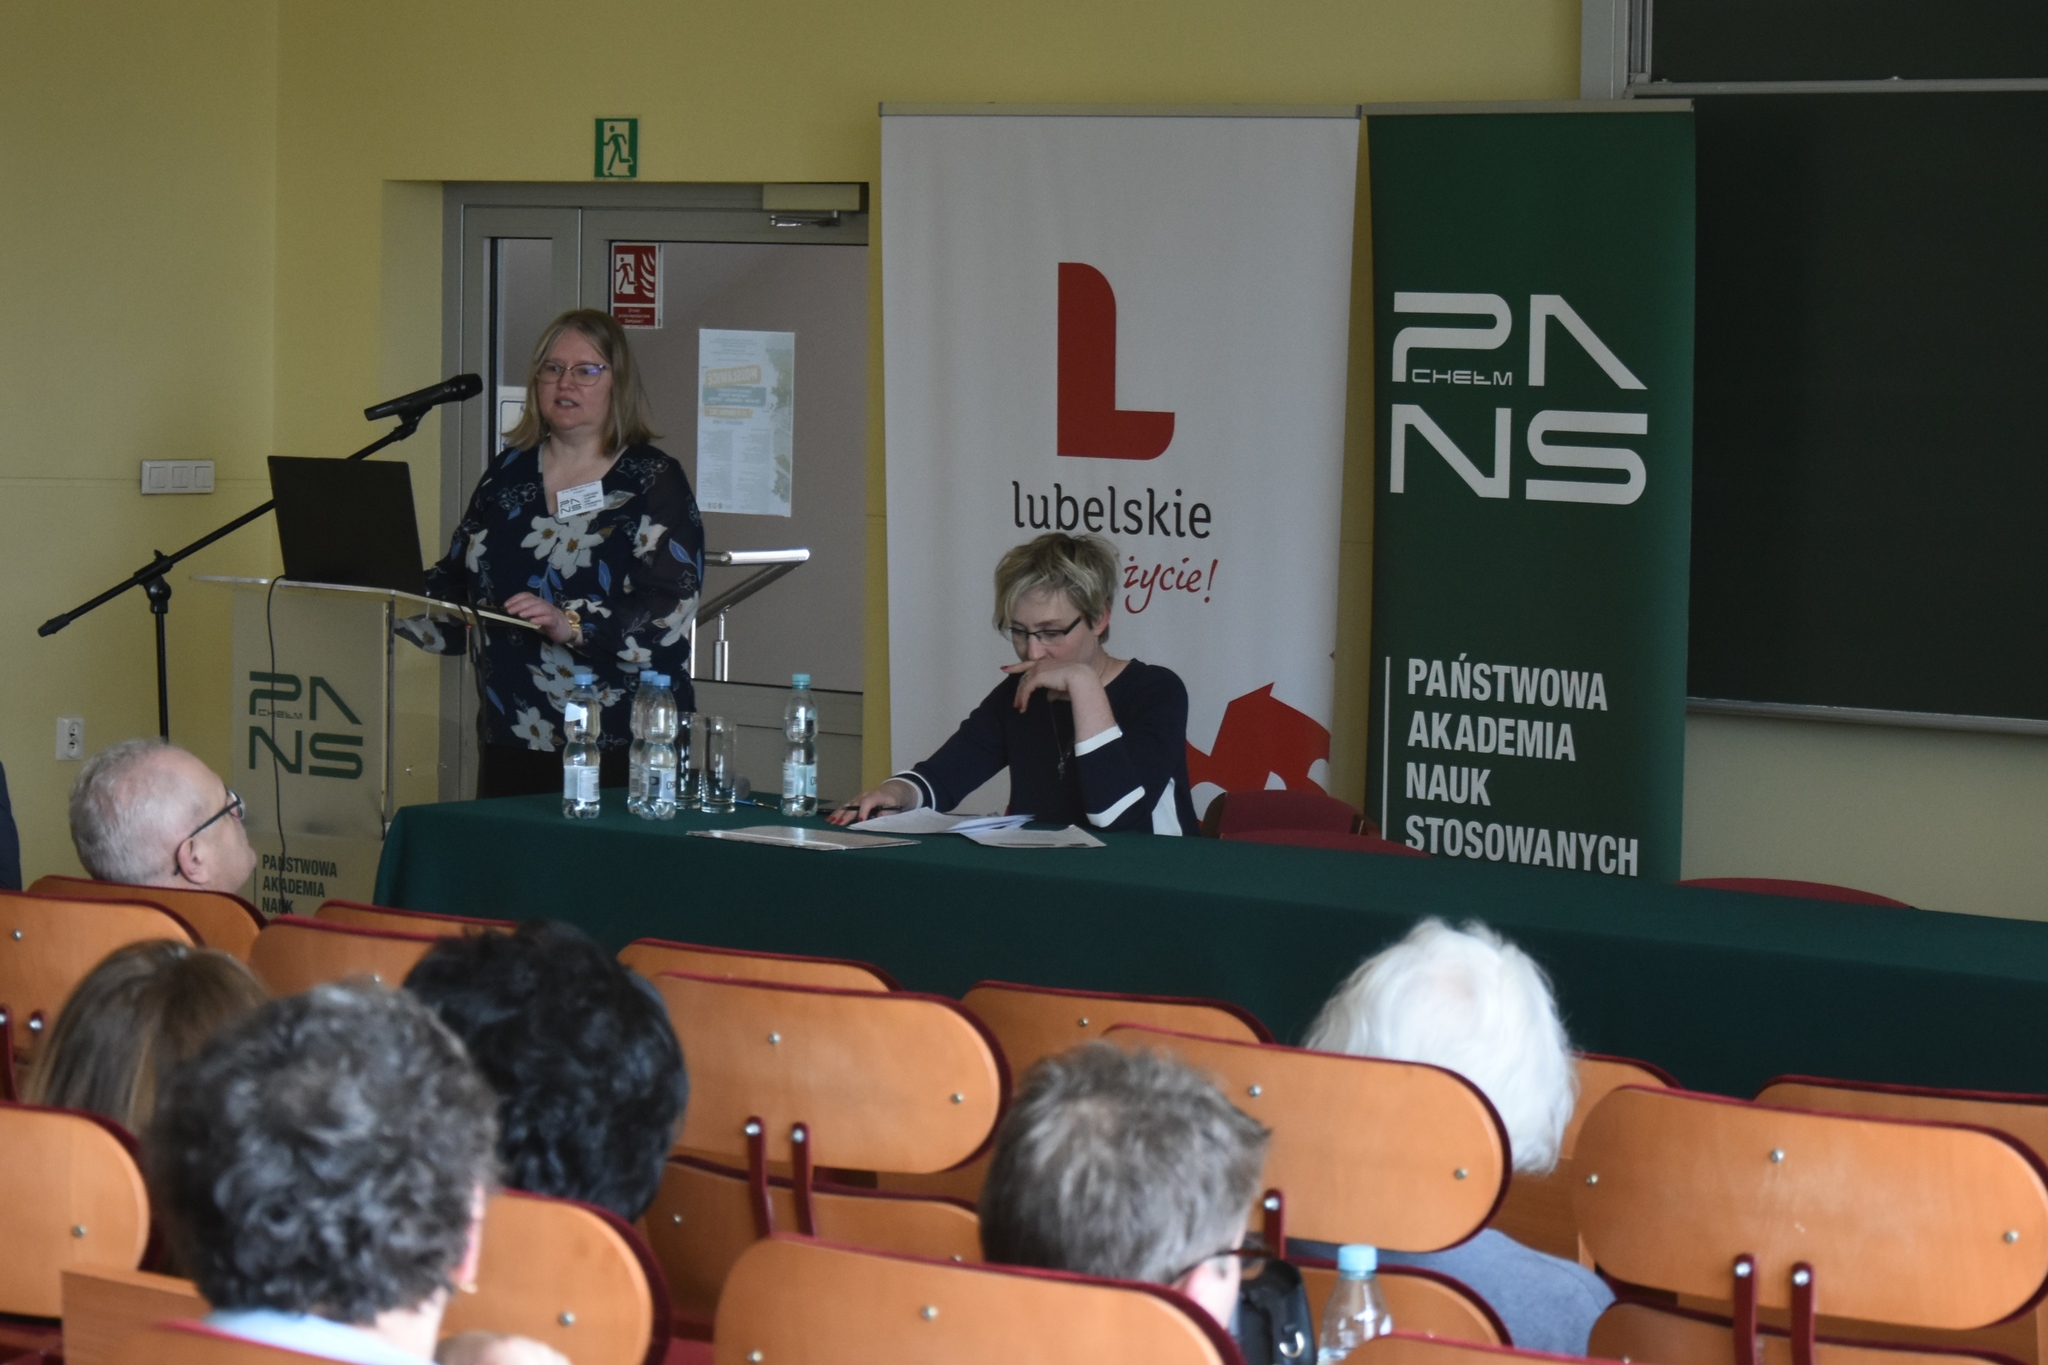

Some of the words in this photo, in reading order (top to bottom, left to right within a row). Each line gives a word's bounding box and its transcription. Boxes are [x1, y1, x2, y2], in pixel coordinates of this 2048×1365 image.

[1412, 368, 1513, 386] CHEŁM
[1012, 480, 1212, 539] lubelskie
[1123, 555, 1219, 614] życie!
[1407, 653, 1608, 711] PAŃSTWOWA
[1407, 710, 1576, 762] AKADEMIA
[1406, 761, 1491, 807] NAUK
[1405, 814, 1639, 877] STOSOWANYCH
[262, 875, 326, 898] AKADEMIA
